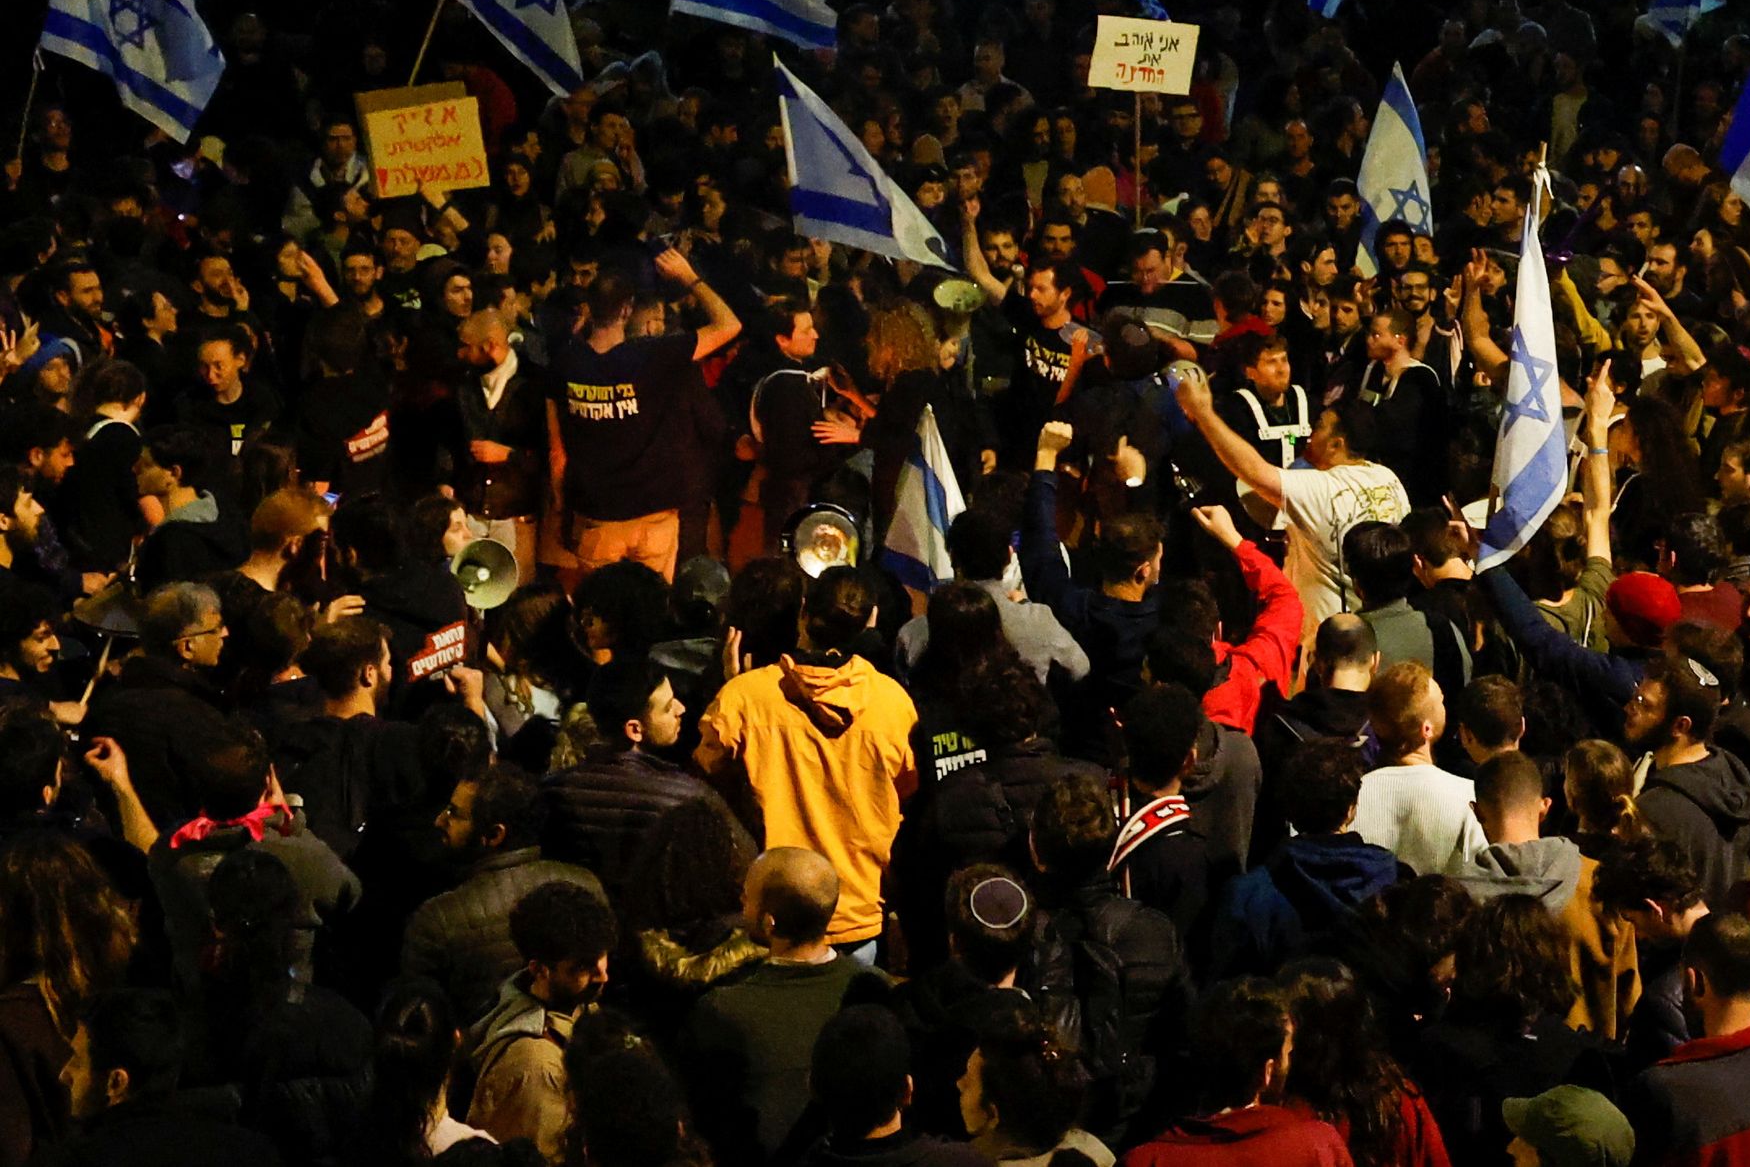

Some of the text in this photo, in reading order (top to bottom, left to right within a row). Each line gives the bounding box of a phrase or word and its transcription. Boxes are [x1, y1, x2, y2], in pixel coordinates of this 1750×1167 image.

[1114, 32, 1180, 52] אני אוהב
[1137, 53, 1162, 66] את
[1115, 63, 1165, 85] המדינה
[615, 398, 639, 420] אין
[935, 749, 987, 781] קדמיה
